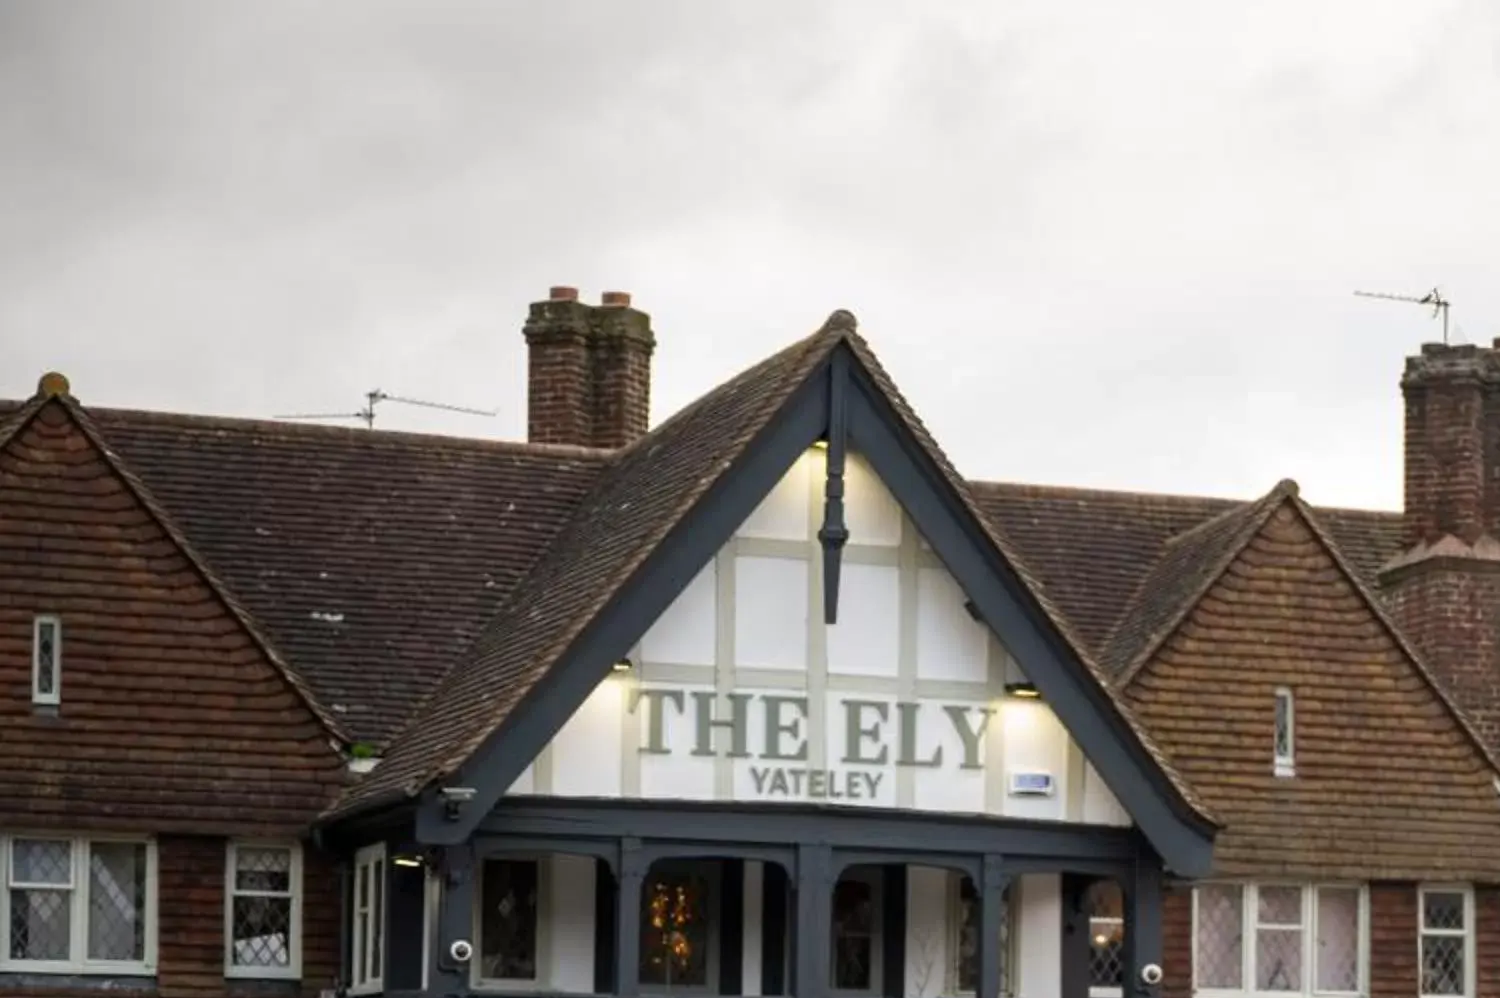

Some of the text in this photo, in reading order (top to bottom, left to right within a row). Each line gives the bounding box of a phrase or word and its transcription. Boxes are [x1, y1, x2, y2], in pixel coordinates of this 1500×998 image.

[629, 689, 997, 769] THE ELY
[751, 767, 883, 798] YATELEY
